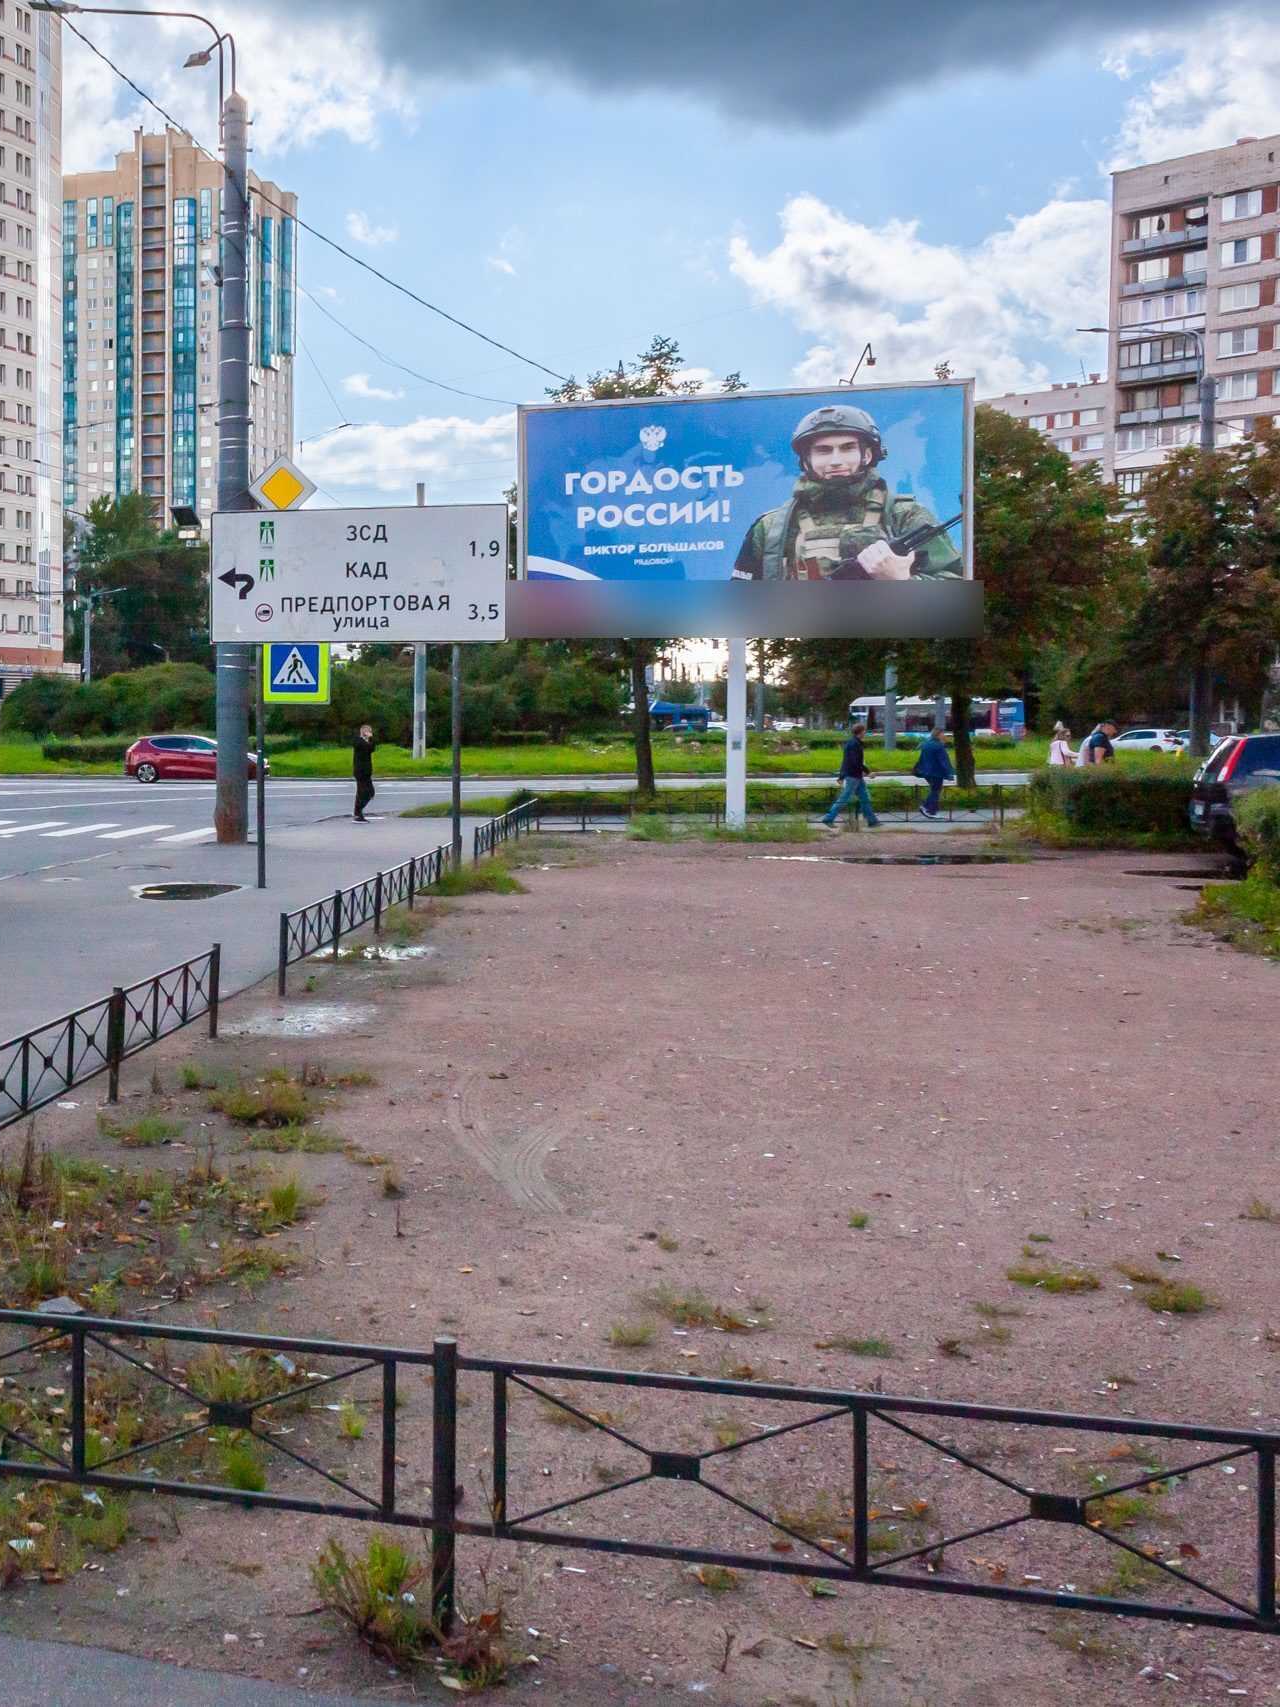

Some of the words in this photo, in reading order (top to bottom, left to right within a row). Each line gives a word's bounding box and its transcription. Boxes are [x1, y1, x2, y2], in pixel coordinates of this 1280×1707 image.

[565, 465, 744, 495] ГОРДОСТЬ
[577, 500, 730, 529] РОССИИ!
[347, 525, 388, 543] ЗСД
[469, 540, 500, 558] 1,9
[584, 544, 635, 556] ВИКТОР
[639, 540, 724, 553] БОЛЬШАКОВ
[346, 561, 388, 579] КАД
[281, 595, 450, 615] ПРЕДПОРТОВАЯ
[468, 604, 499, 622] 3,5
[333, 615, 389, 632] улица
